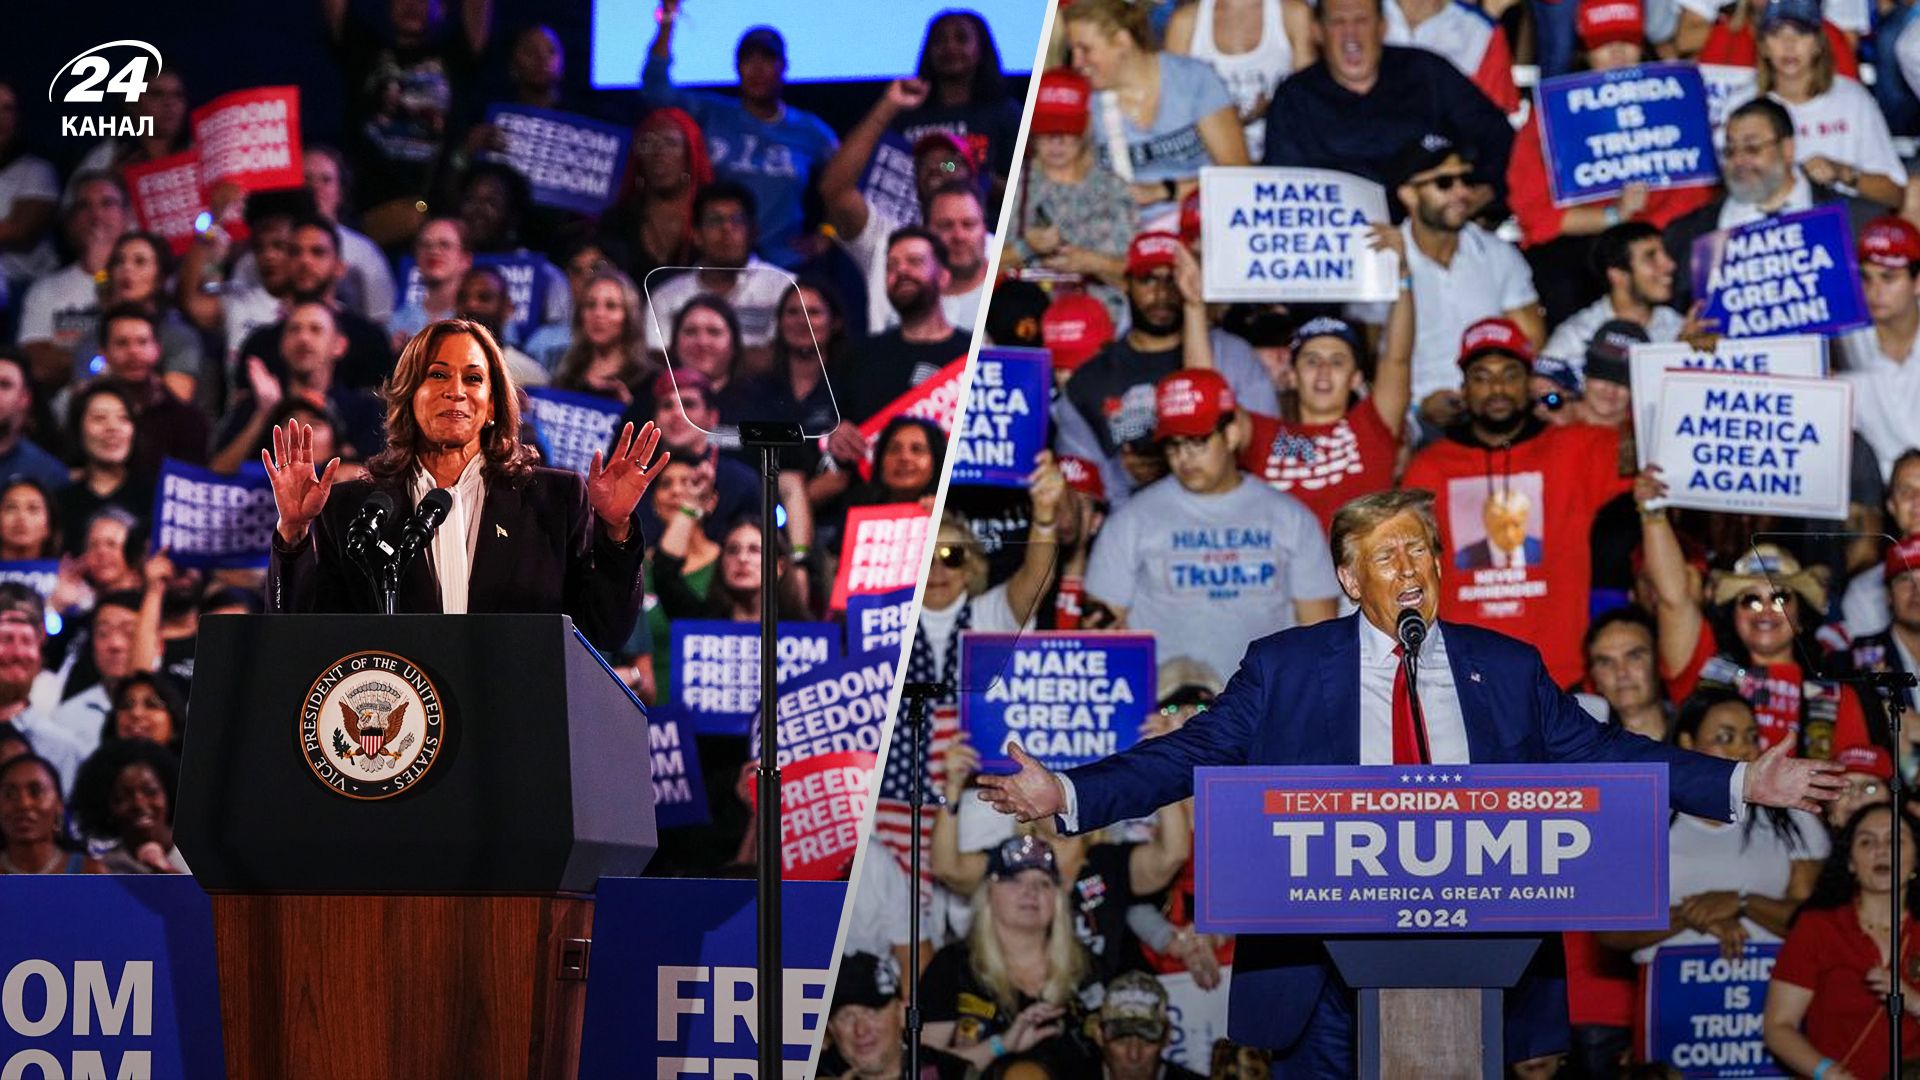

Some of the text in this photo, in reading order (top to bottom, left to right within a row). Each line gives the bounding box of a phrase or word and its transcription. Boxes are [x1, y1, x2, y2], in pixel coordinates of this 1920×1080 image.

[1567, 76, 1685, 114] FLORIDA
[1616, 104, 1646, 129] IS
[1585, 124, 1681, 157] TRUMP
[1574, 147, 1701, 187] COUNTRY
[1255, 183, 1340, 202] MAKE
[1229, 208, 1368, 228] AMERICA
[1249, 233, 1352, 254] GREAT
[1726, 223, 1806, 262] MAKE
[1247, 259, 1355, 280] AGAIN!
[1706, 244, 1835, 293] AMERICA
[1721, 272, 1820, 313] GREAT
[1727, 296, 1831, 337] AGAIN!
[1705, 389, 1793, 416] MAKE
[1676, 414, 1820, 445] AMERICA
[1692, 442, 1800, 469] GREAT
[1688, 468, 1802, 496] AGAIN!
[1172, 527, 1272, 551] HIALEAH
[1171, 562, 1277, 587] TRUMP
[683, 634, 829, 664] FREEOM
[1013, 650, 1108, 677] MAKE
[984, 675, 1134, 704] AMERICA
[303, 657, 440, 792] VICE PRESIDENT OF THE UNITED STATES
[1004, 703, 1116, 730] GREAT
[1000, 730, 1118, 757] AGAIN!
[1281, 790, 1584, 812] TEXT FLORIDA TO 88022
[1273, 819, 1592, 878] TRUMP
[1289, 886, 1576, 902] MAKE AMERICA GREAT AGAIN!
[1396, 908, 1469, 928] 2024
[1723, 985, 1751, 1010] IS
[1672, 1040, 1773, 1068] COUNT
